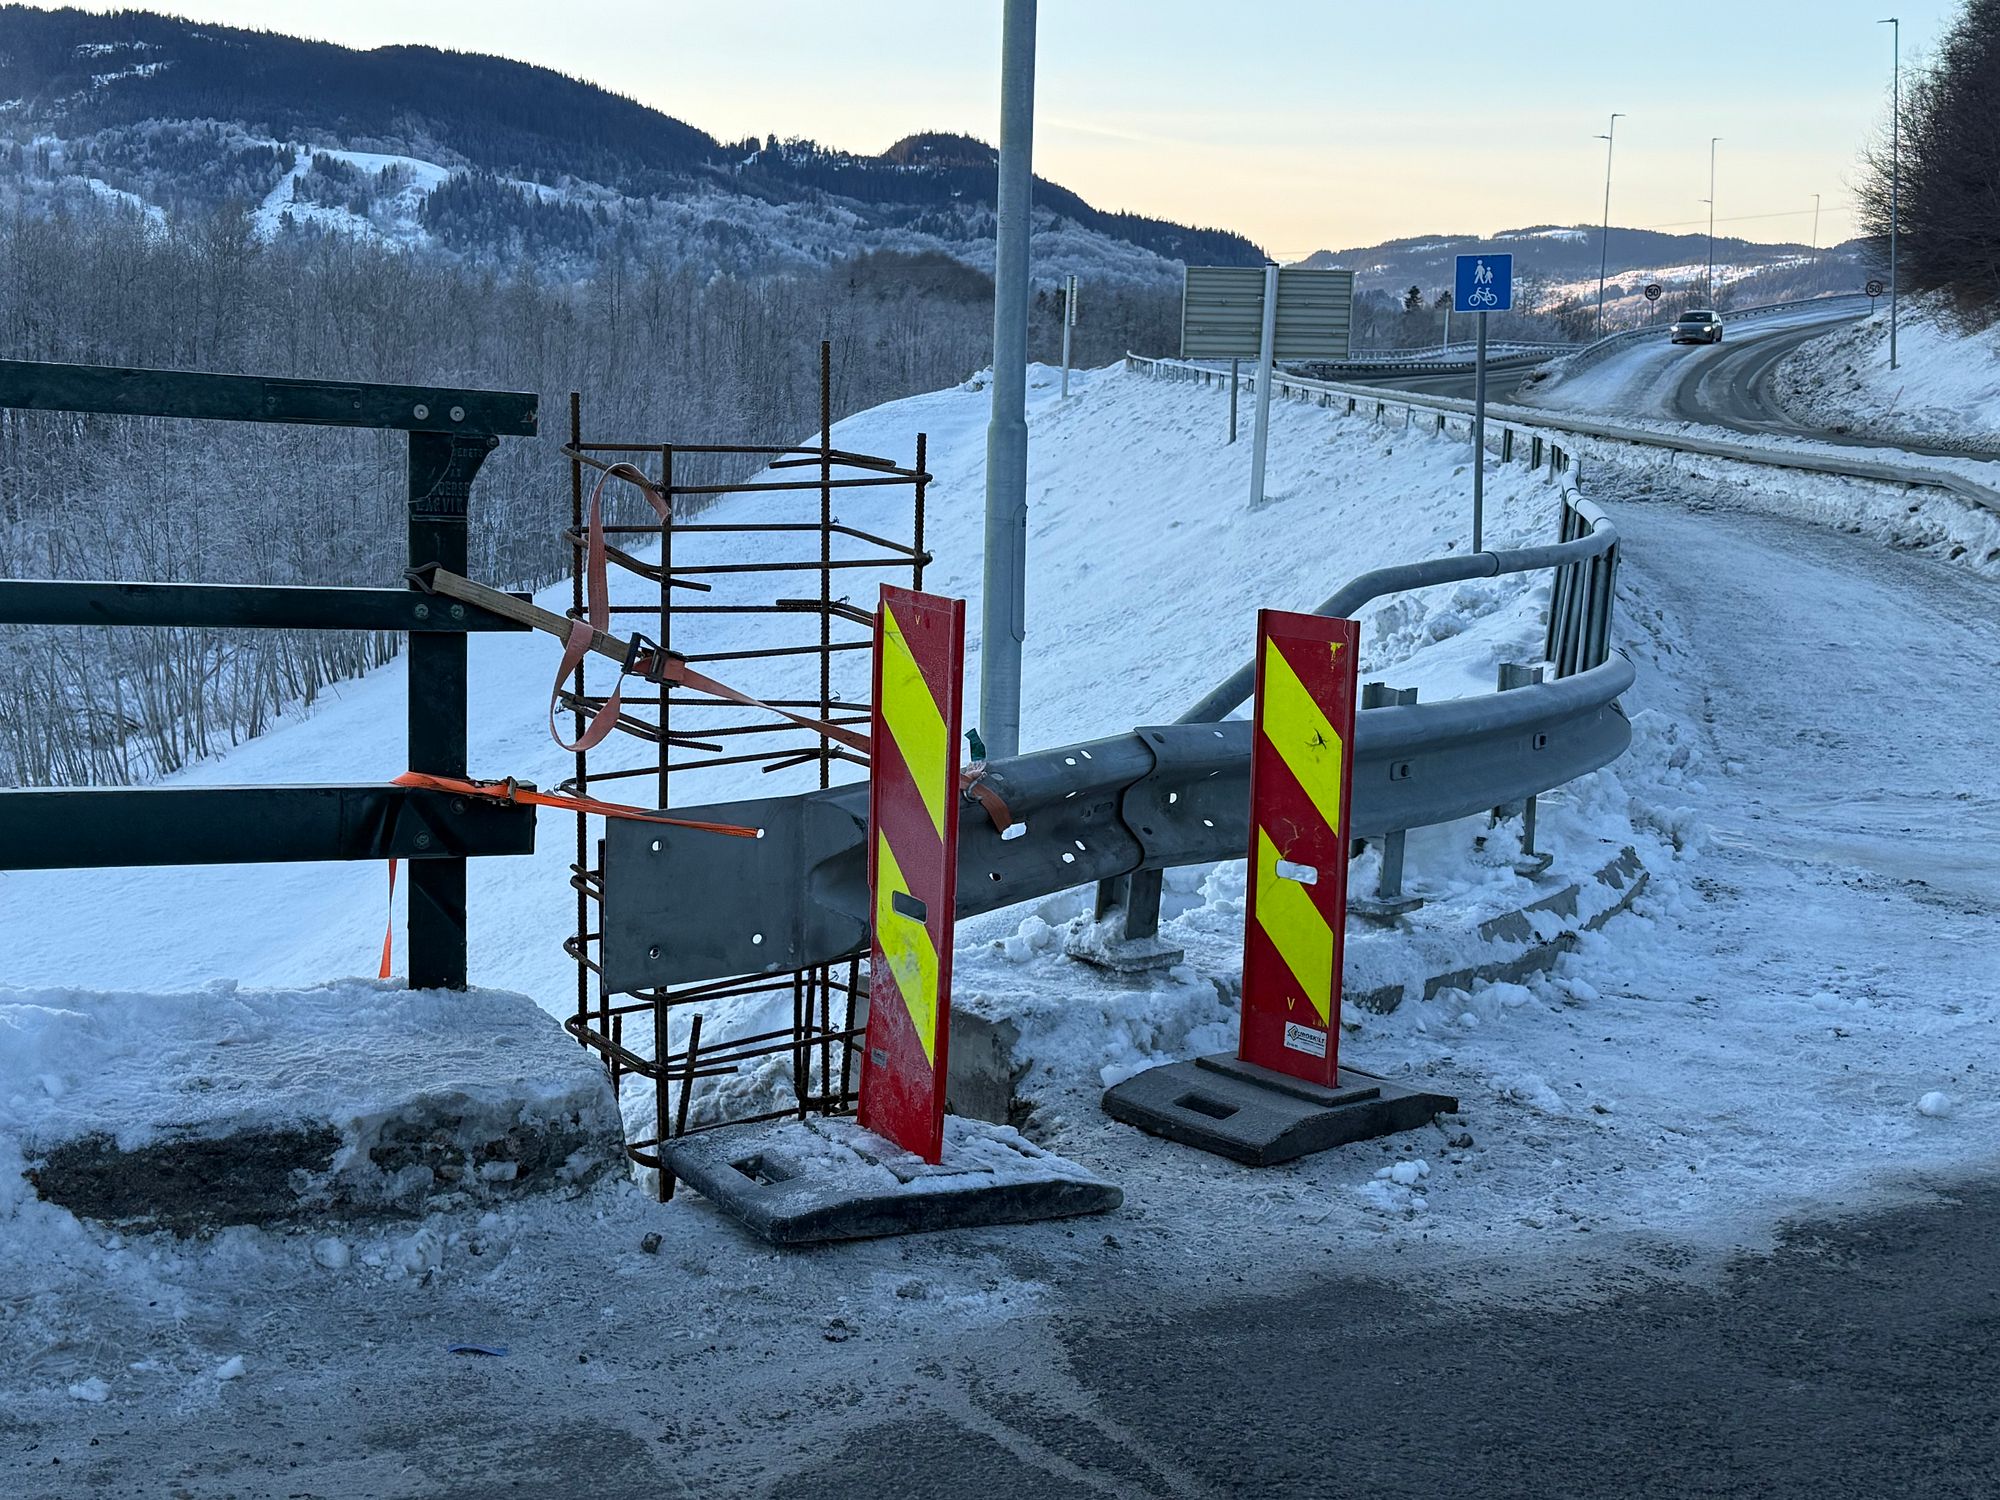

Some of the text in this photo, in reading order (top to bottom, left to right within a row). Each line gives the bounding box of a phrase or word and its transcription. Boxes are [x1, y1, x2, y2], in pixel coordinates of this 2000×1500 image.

[1648, 287, 1659, 297] 50
[1869, 284, 1880, 293] 50
[1286, 996, 1296, 1011] V
